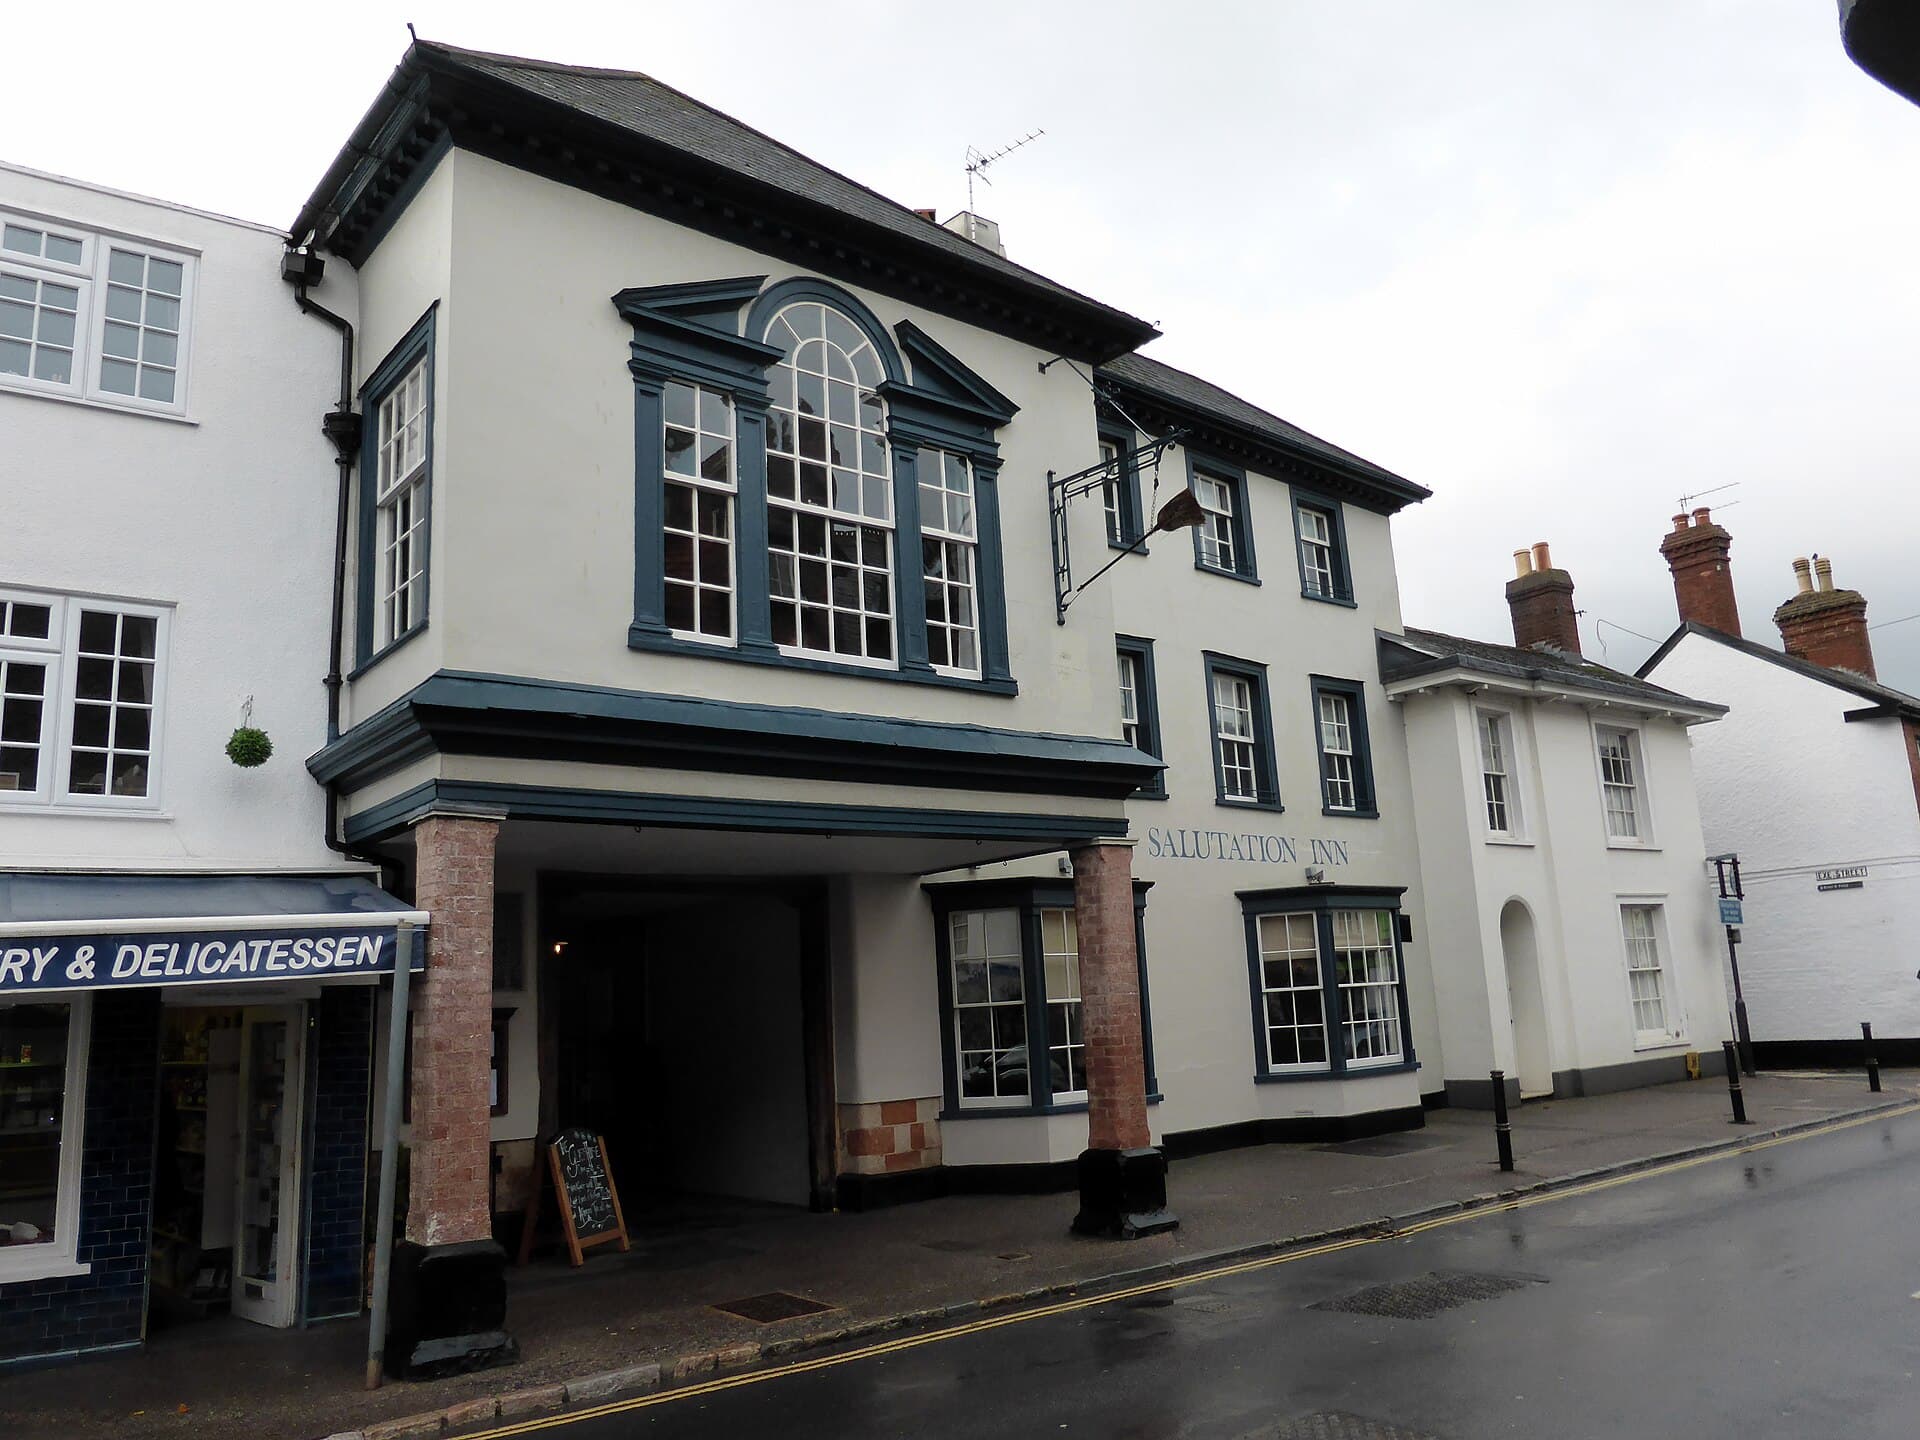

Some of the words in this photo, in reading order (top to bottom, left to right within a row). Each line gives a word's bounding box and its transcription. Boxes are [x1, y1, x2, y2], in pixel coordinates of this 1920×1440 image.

[1148, 827, 1297, 864] SALUTATION
[1310, 839, 1349, 866] INN
[1836, 867, 1865, 878] STREET
[0, 946, 59, 983] RY
[66, 945, 95, 980] &
[111, 935, 384, 979] DELICATESSEN
